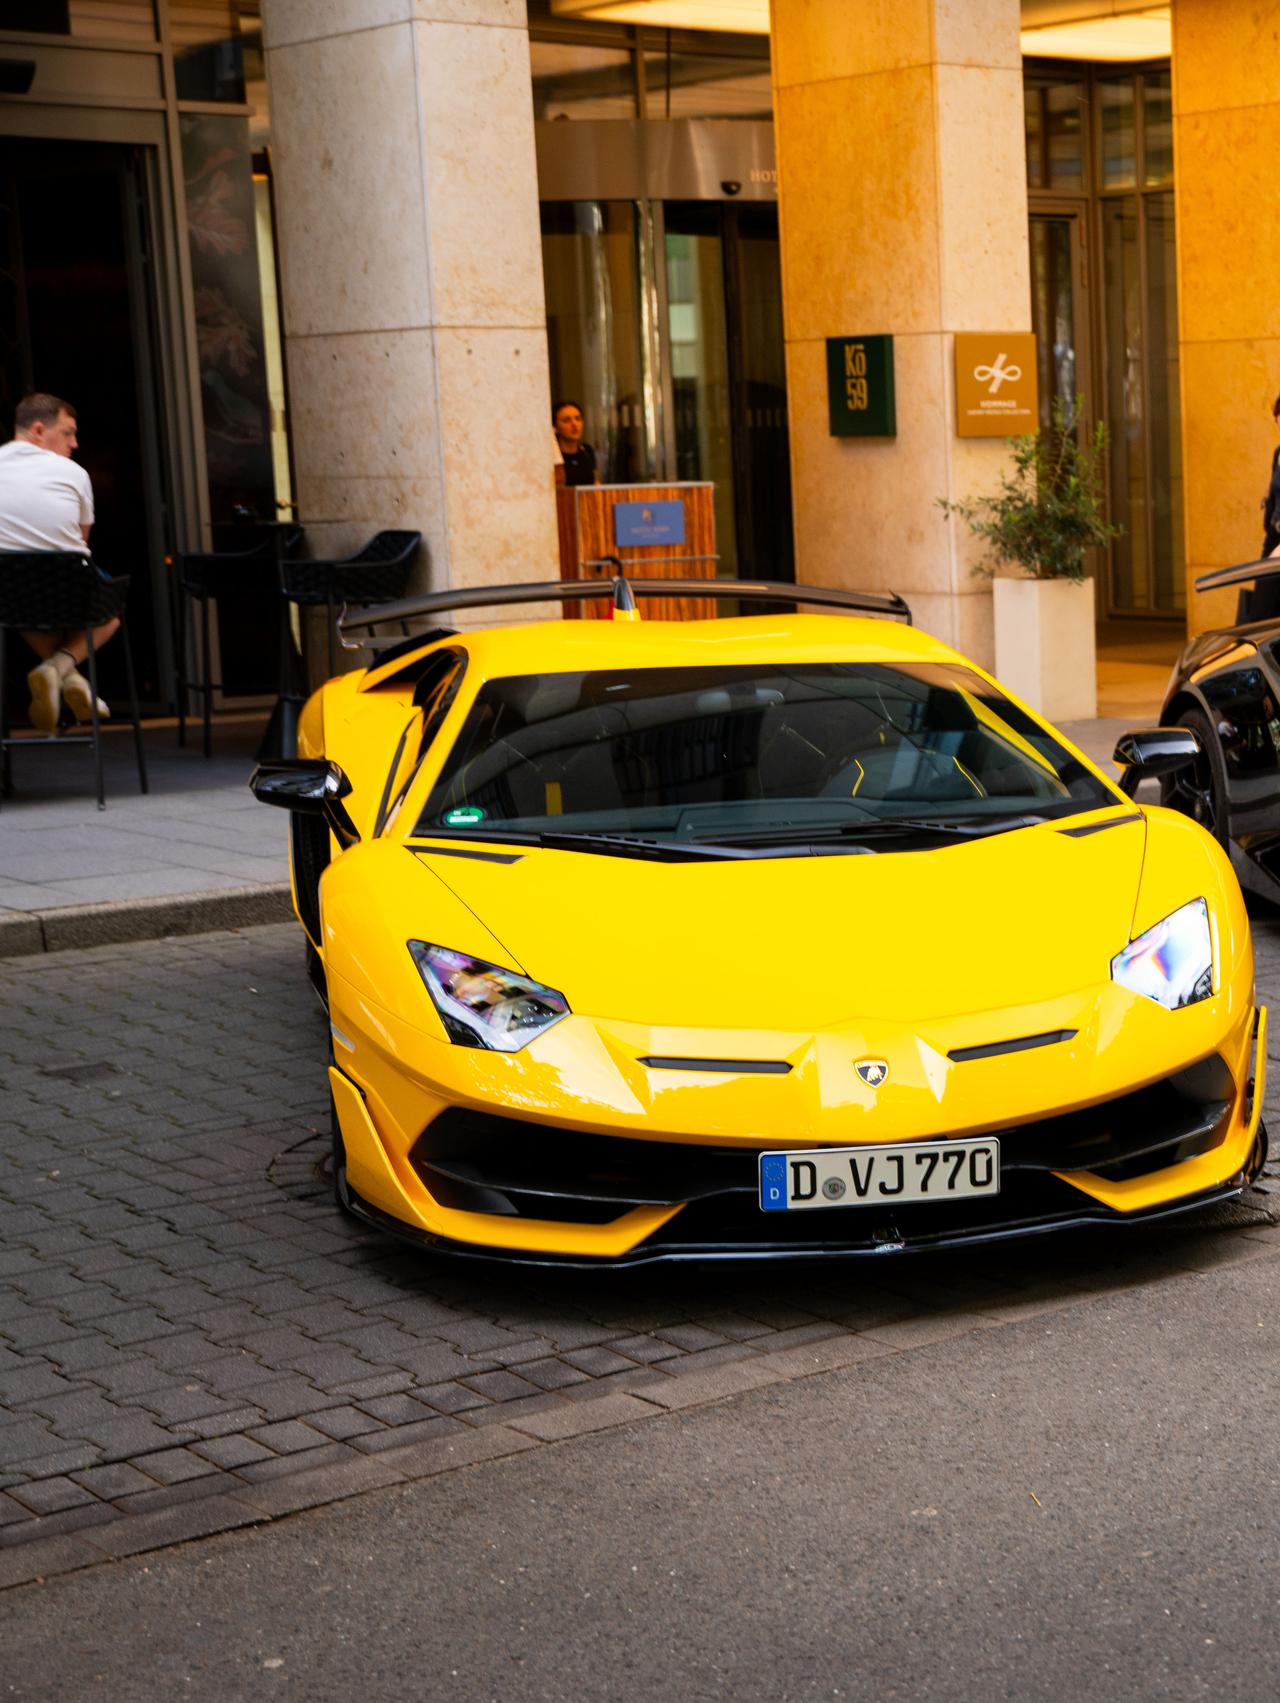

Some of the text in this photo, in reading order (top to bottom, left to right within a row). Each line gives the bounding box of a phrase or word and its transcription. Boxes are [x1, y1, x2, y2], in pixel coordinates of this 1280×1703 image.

[846, 377, 868, 411] 59
[979, 399, 1017, 408] HOMMAGE
[789, 1160, 818, 1201] D
[769, 1187, 780, 1200] D
